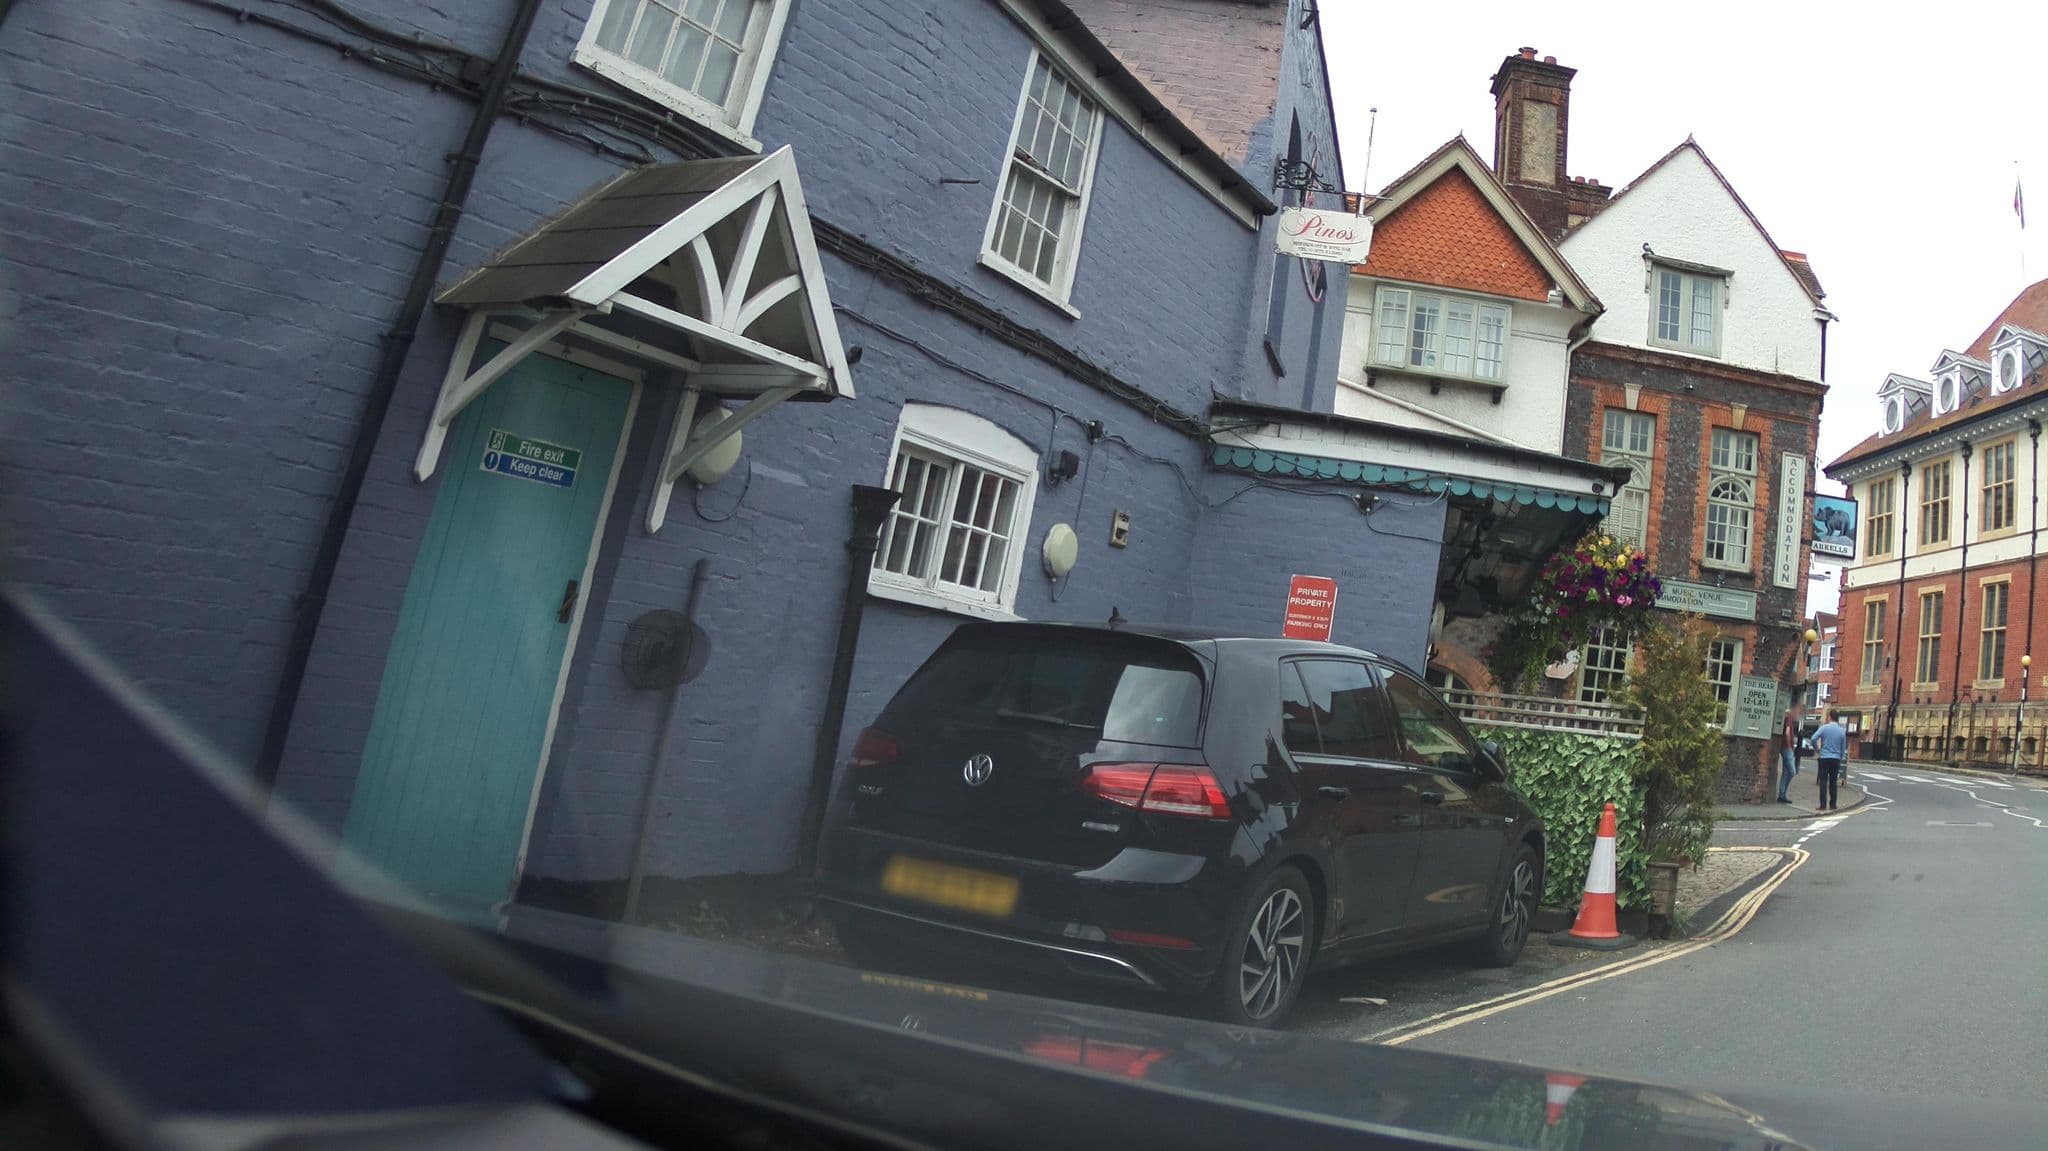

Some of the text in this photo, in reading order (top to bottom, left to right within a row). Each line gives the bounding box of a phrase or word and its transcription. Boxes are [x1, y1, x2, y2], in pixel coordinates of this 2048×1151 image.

[519, 440, 565, 463] Fire exit
[510, 458, 563, 481] Keep clear
[1781, 458, 1797, 583] ACCOMMODATION
[1297, 587, 1329, 598] PRIVATE
[1289, 597, 1333, 608] PROPERTY
[1313, 622, 1329, 630] ONLY
[1748, 690, 1766, 699] OPEN
